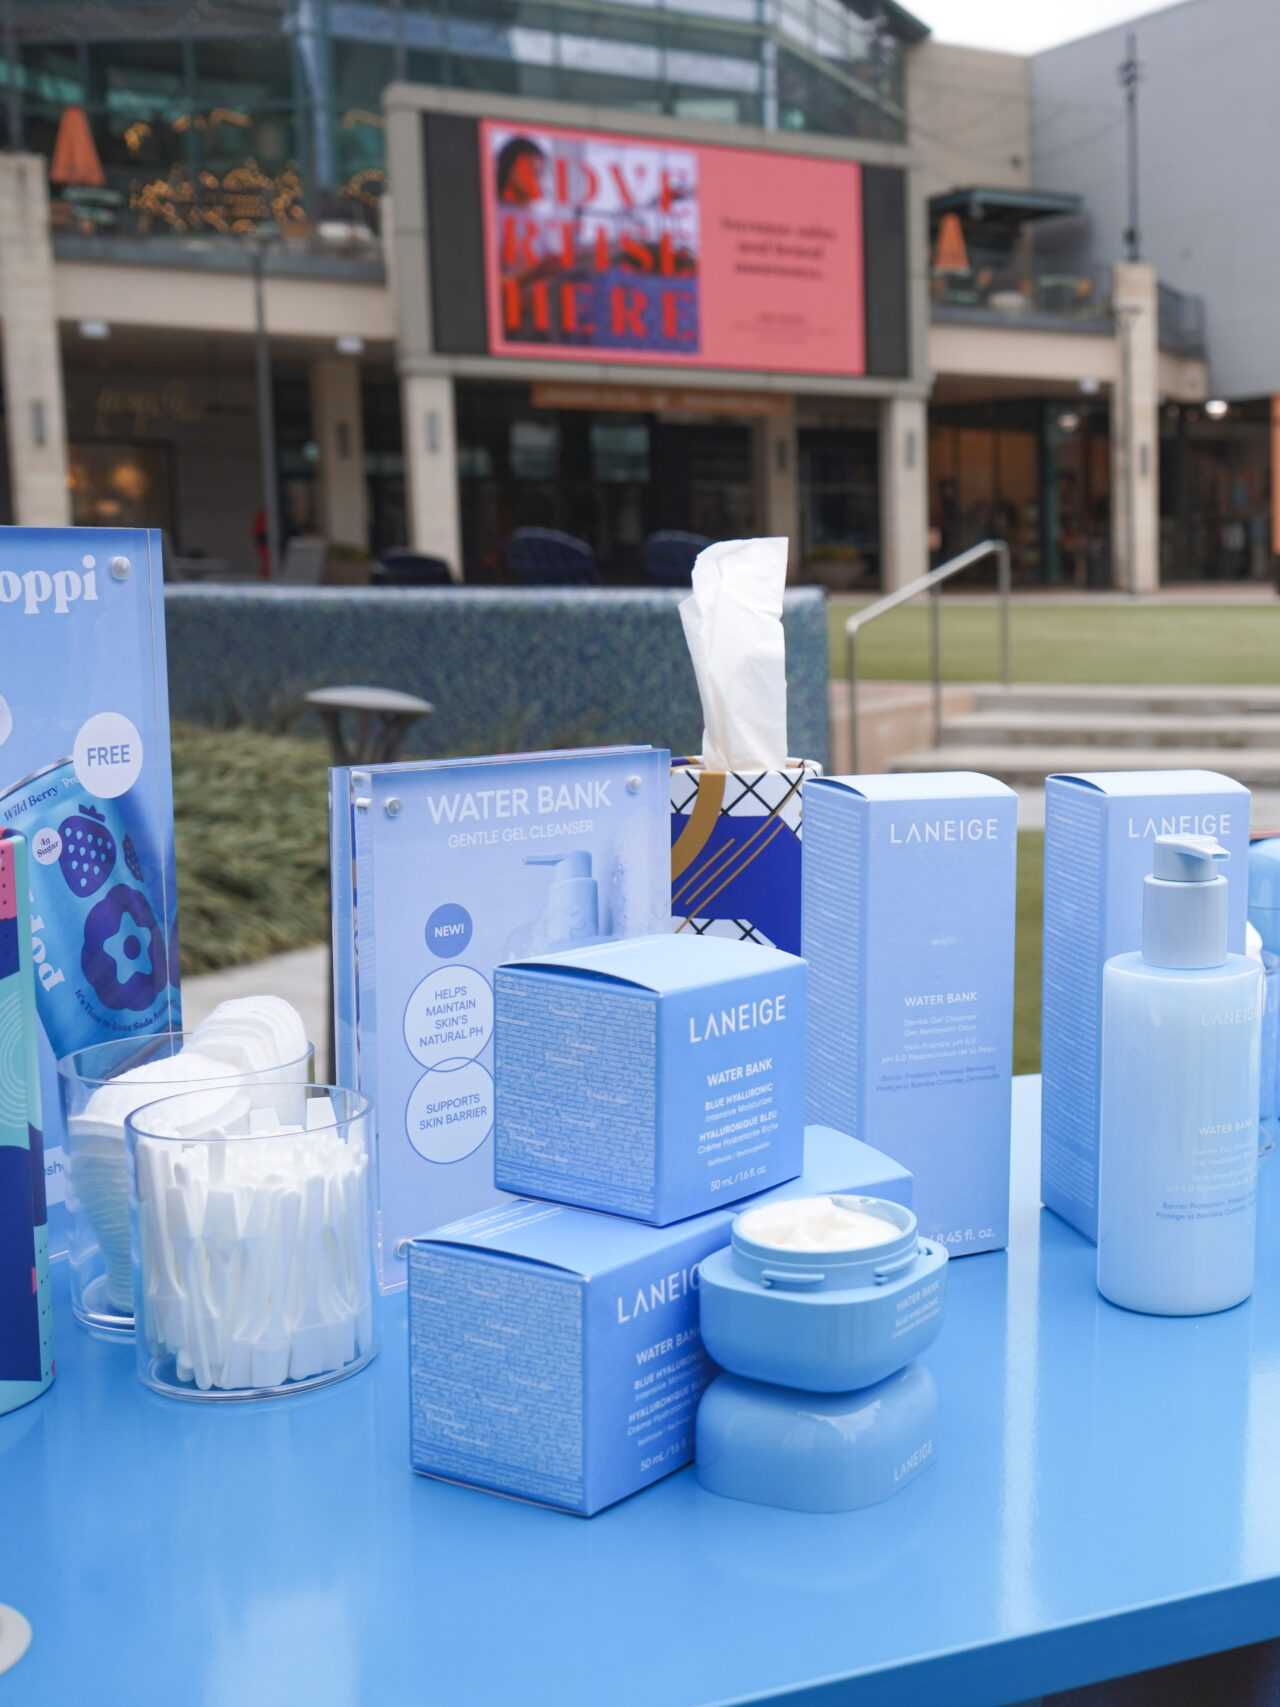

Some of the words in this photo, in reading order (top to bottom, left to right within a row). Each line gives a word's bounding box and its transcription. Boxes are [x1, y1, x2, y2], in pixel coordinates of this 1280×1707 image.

[501, 153, 694, 218] ADVE
[503, 214, 695, 277] RTISE
[504, 278, 695, 340] HERE
[0, 554, 98, 615] oppi
[87, 744, 131, 767] FREE
[3, 800, 28, 821] Wild
[27, 785, 58, 807] Berry
[427, 788, 531, 825] WATER
[537, 780, 612, 814] BANK
[448, 830, 499, 848] GENTLE
[502, 827, 526, 842] GEL
[530, 819, 593, 840] CLEANSER
[890, 817, 998, 845] LANEIGE
[1128, 814, 1232, 839] LANEIGE
[36, 841, 59, 857] Sugar
[434, 923, 465, 938] NEW!
[434, 986, 467, 1001] HELPS
[904, 994, 944, 1008] WATER
[946, 991, 978, 1004] BANK
[425, 998, 476, 1016] MAINTAIN
[689, 994, 787, 1044] LANEIGE
[132, 1018, 153, 1031] Soda
[435, 1014, 468, 1030] SKIN'S
[419, 1028, 467, 1047] NATURAL
[469, 1026, 483, 1039] PH
[707, 1067, 744, 1087] WATER
[745, 1057, 773, 1076] BANK
[426, 1093, 480, 1114] SUPPORTS
[705, 1096, 726, 1111] BLUE
[726, 1083, 774, 1104] HYALURONIC
[419, 1115, 444, 1130] SKIN
[446, 1106, 487, 1124] BARRIER
[700, 1116, 758, 1142] HYALURONIQUE
[759, 1109, 778, 1124] BLEU
[1199, 1123, 1233, 1136] WATER
[710, 1178, 721, 1192] 50
[936, 1230, 962, 1245] 8.45
[964, 1228, 976, 1241] fl.
[978, 1227, 996, 1239] oz.
[617, 1263, 701, 1324] LANEIG
[635, 1338, 674, 1366] WATER
[676, 1327, 701, 1347] BAN
[633, 1373, 655, 1391] BLUE
[628, 1385, 689, 1424] HYALURONIQUE
[894, 1439, 934, 1483] LANEIGE
